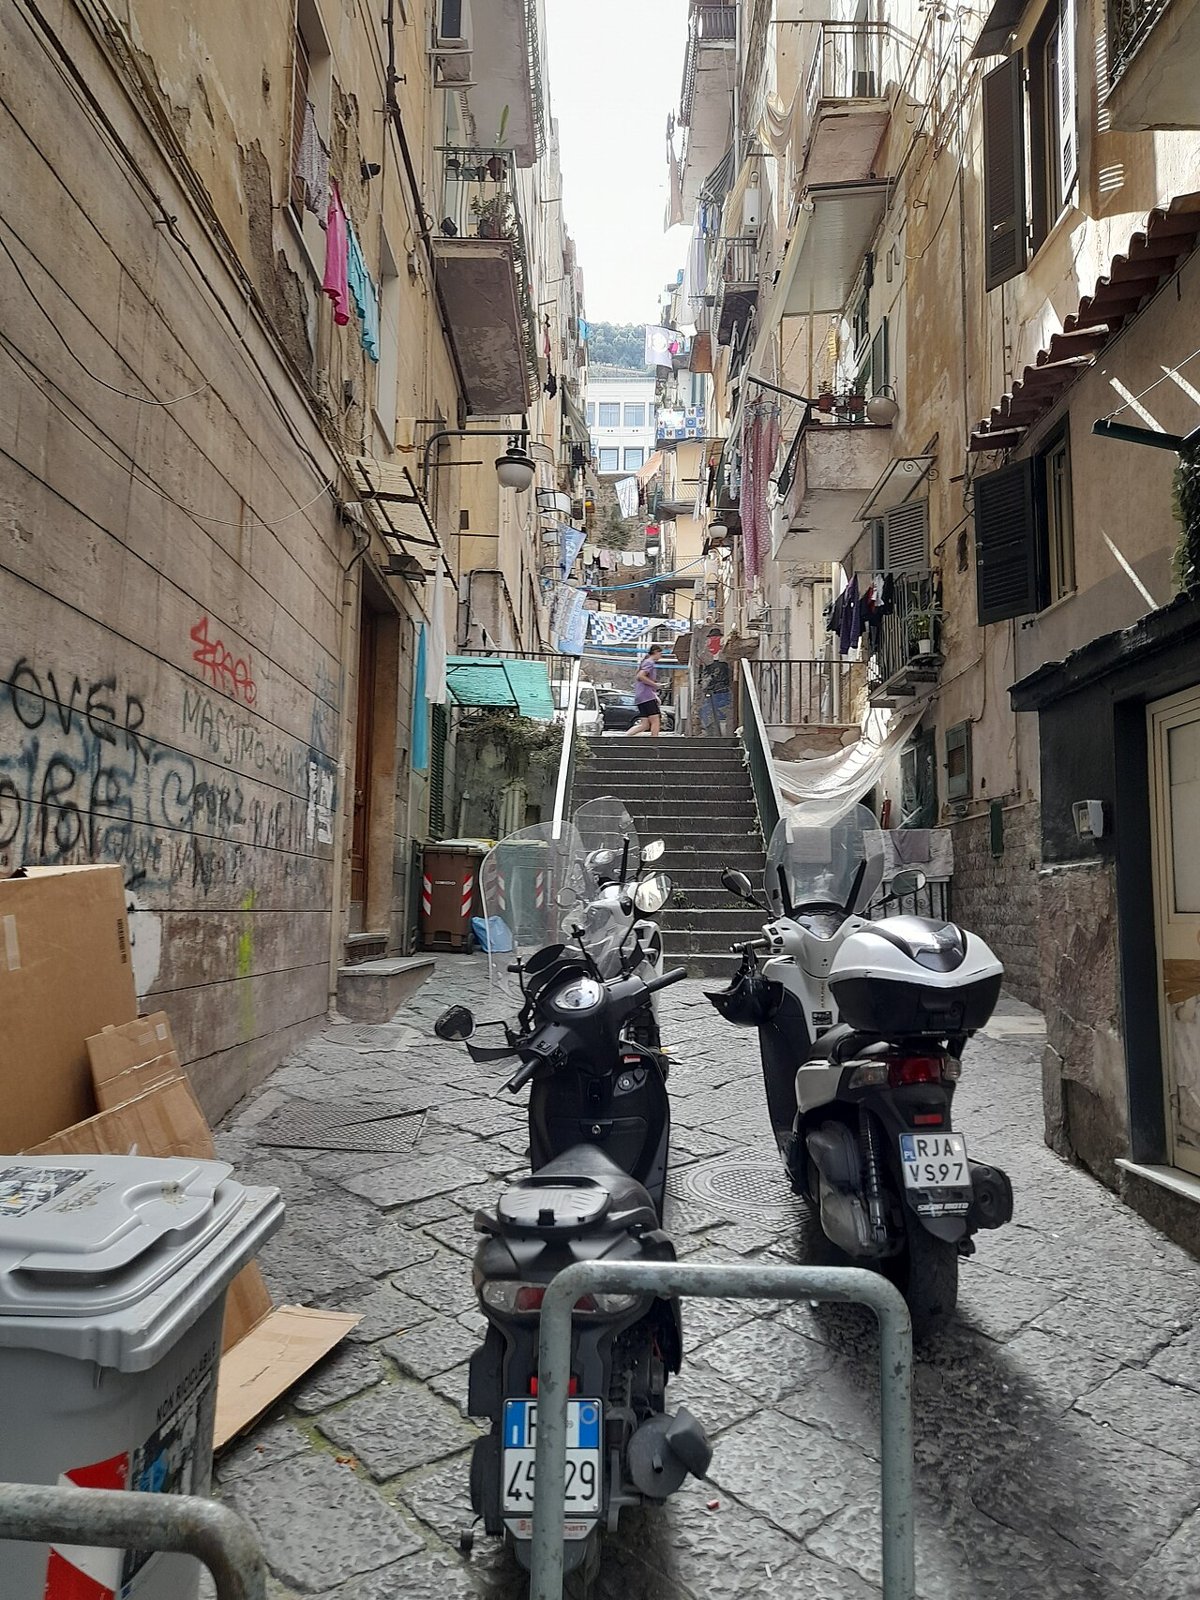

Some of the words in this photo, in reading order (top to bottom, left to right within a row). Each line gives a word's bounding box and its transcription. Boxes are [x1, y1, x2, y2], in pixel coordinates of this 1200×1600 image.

[8, 657, 149, 765] OVER
[916, 1138, 954, 1157] RJA
[909, 1163, 963, 1182] VS97
[507, 1461, 595, 1501] 4529
